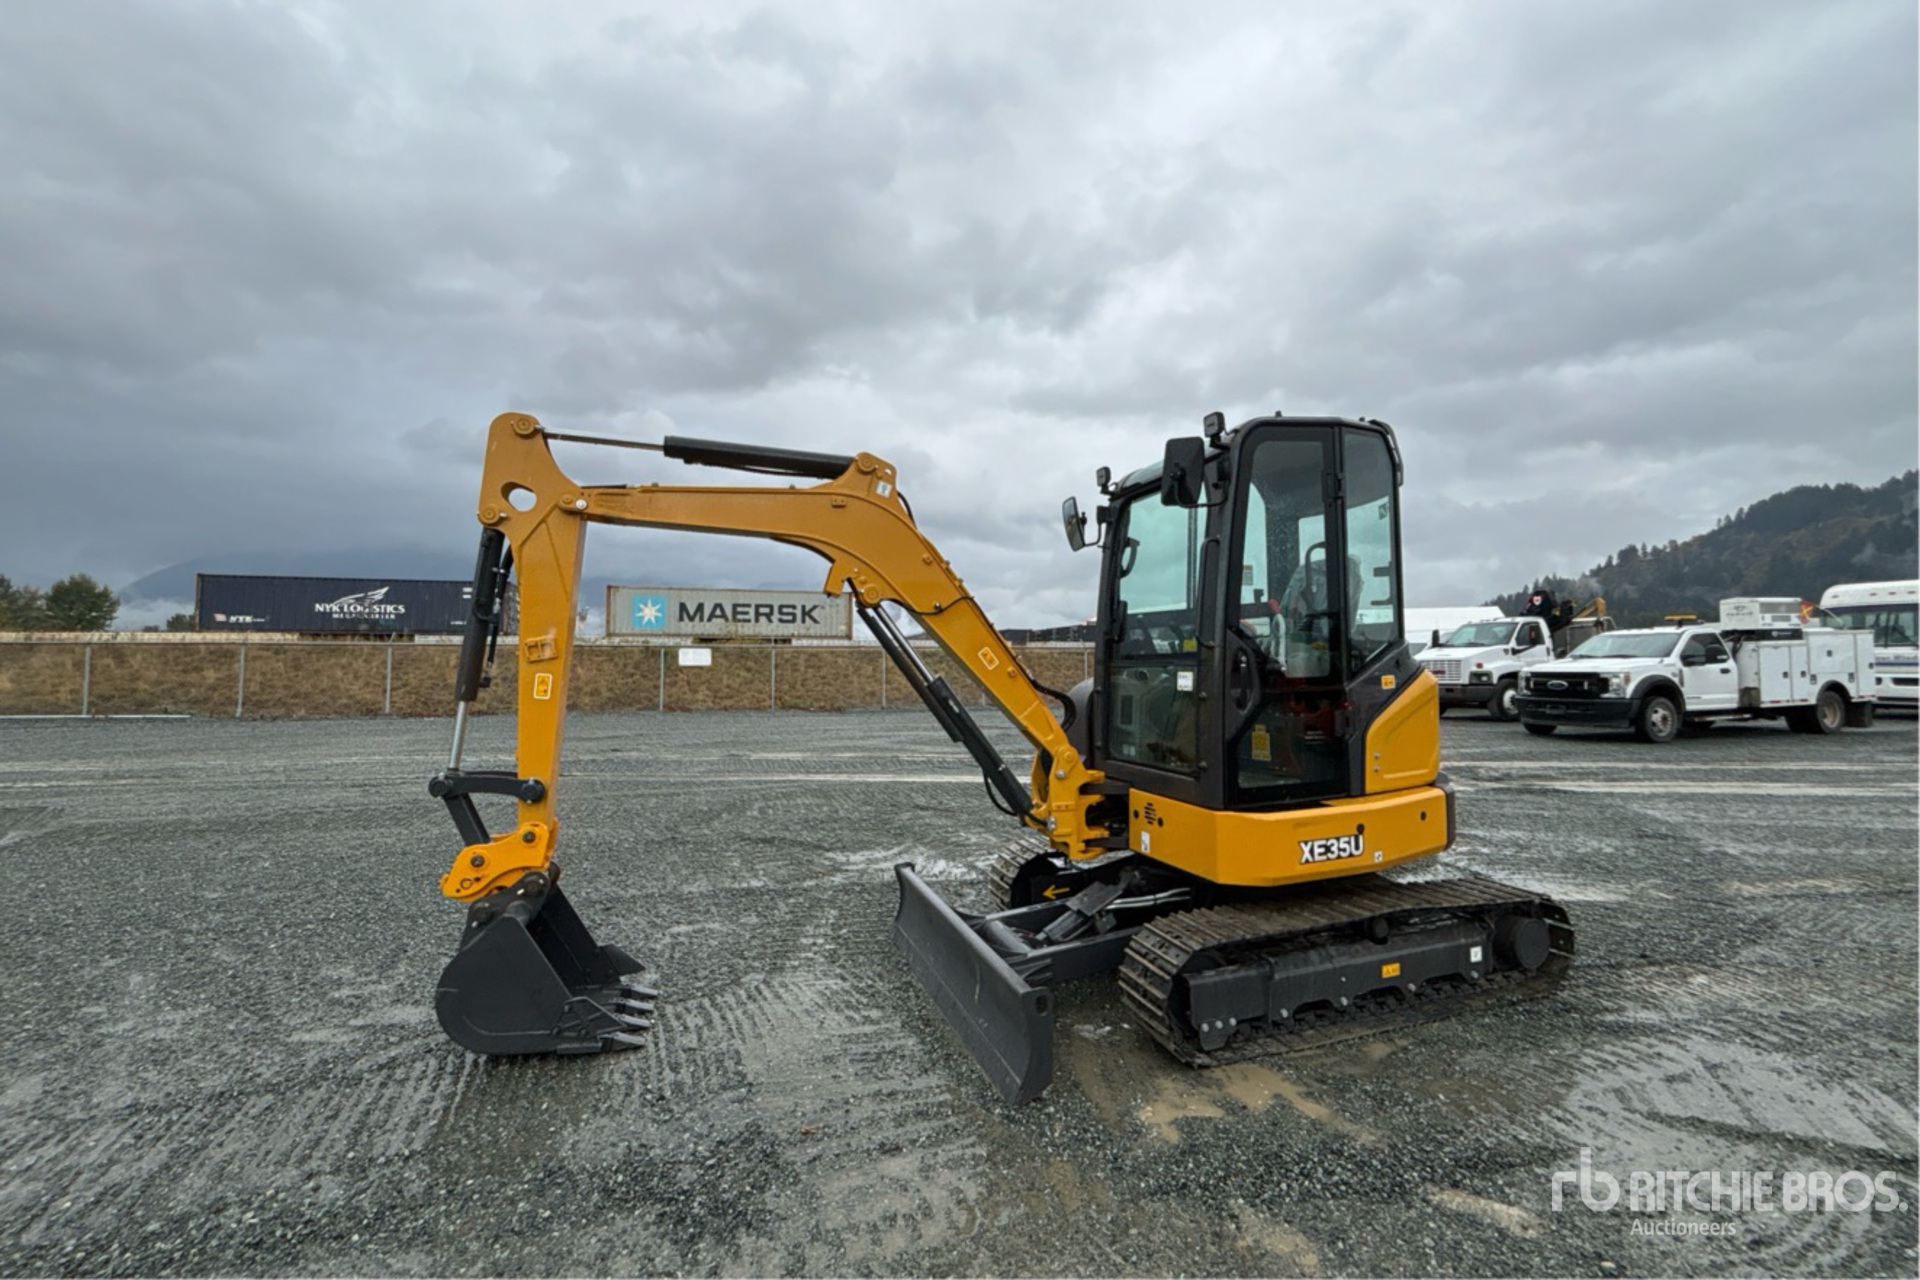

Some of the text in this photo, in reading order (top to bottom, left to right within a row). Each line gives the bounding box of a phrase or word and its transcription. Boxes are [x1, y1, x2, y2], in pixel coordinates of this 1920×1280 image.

[314, 603, 406, 614] NYK LOGSTICS
[678, 602, 821, 625] MAERSK
[1300, 834, 1364, 864] XE35U
